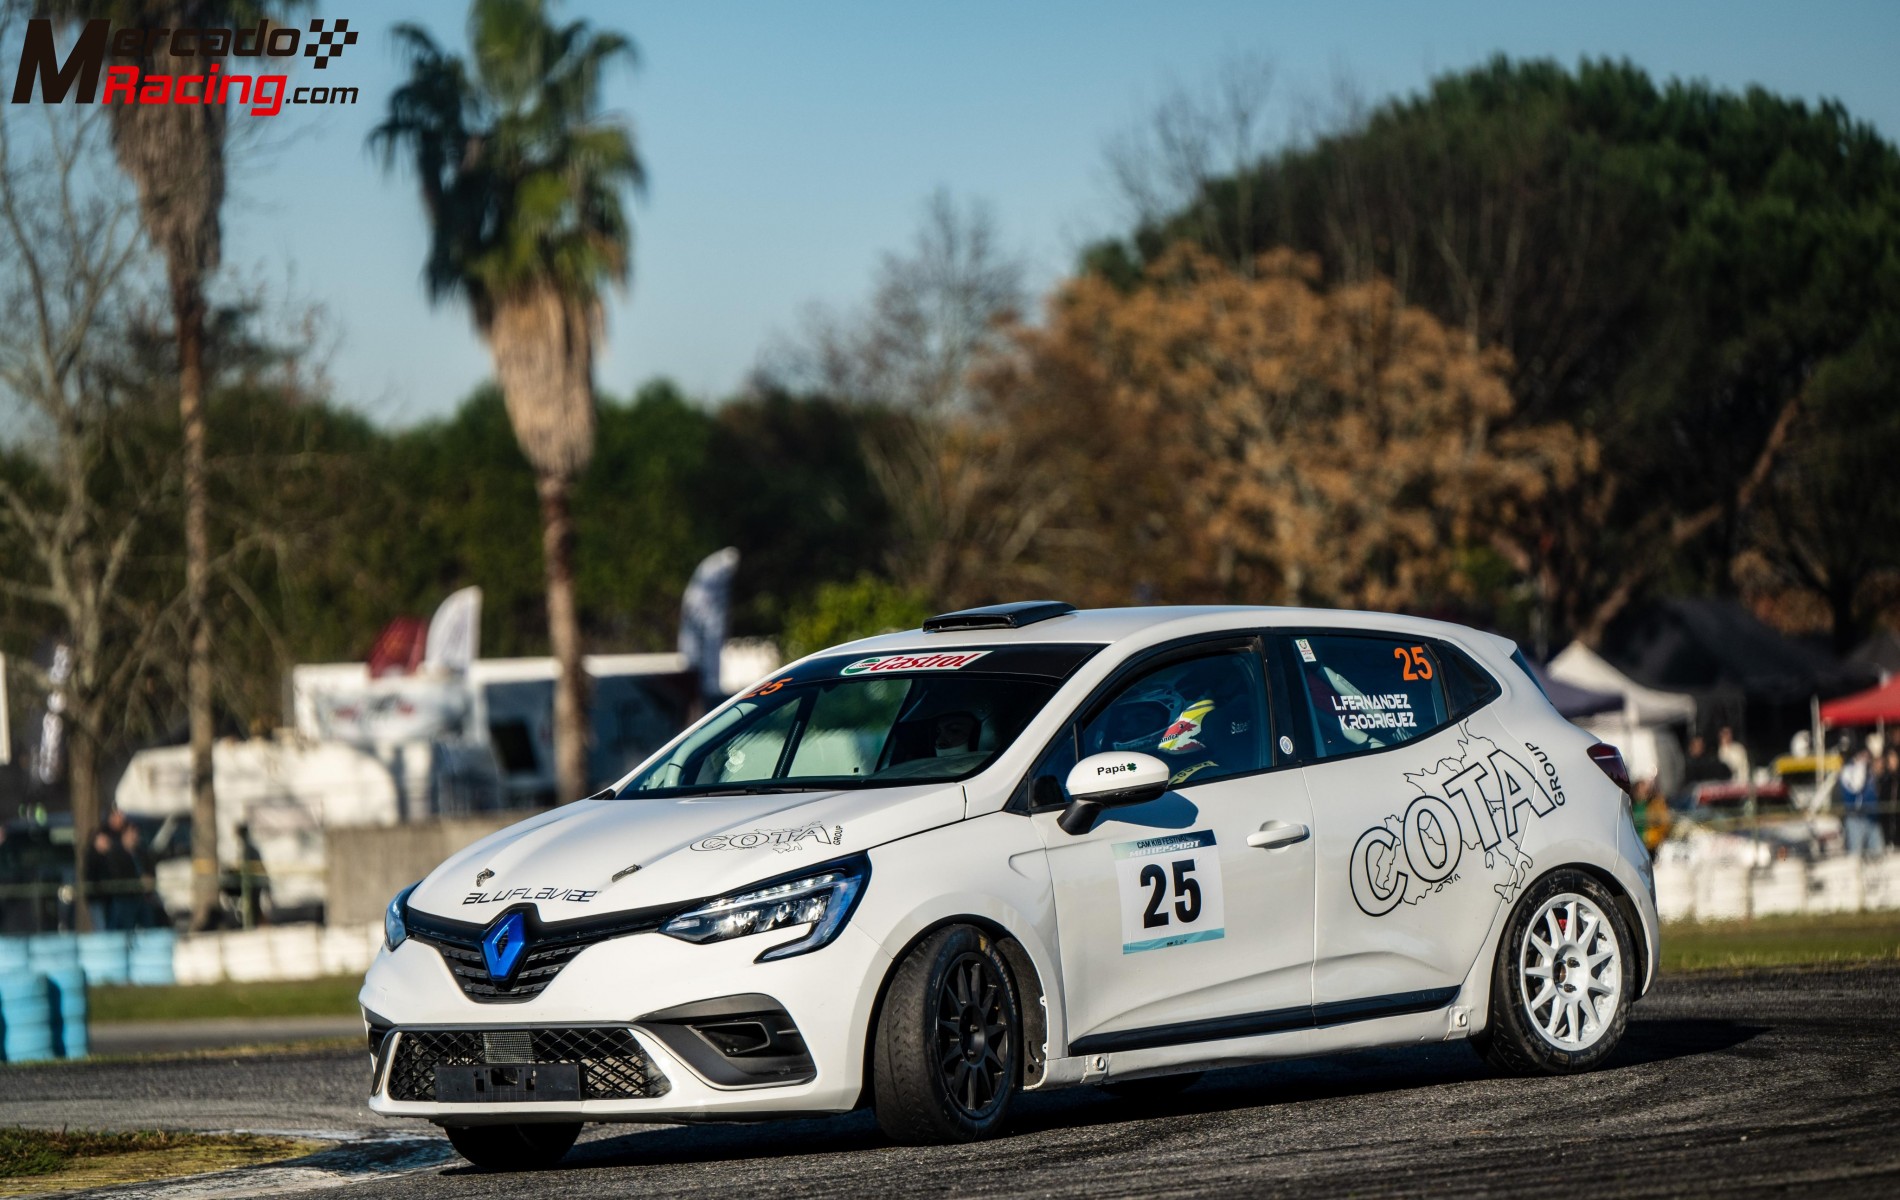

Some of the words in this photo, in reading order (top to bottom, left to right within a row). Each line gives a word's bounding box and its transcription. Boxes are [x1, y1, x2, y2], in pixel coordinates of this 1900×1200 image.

[869, 653, 981, 672] Castrol
[1394, 646, 1432, 681] 25
[743, 677, 794, 700] 25
[1331, 693, 1411, 711] L.FERNANDEZ
[1097, 763, 1126, 776] Papá
[690, 825, 832, 851] COTA
[833, 825, 843, 846] GROUP
[1349, 749, 1557, 917] COTA
[1525, 741, 1566, 807] GROUP
[1136, 840, 1151, 849] CAM
[1162, 835, 1188, 846] FESTIVAL
[1140, 859, 1202, 930] 25
